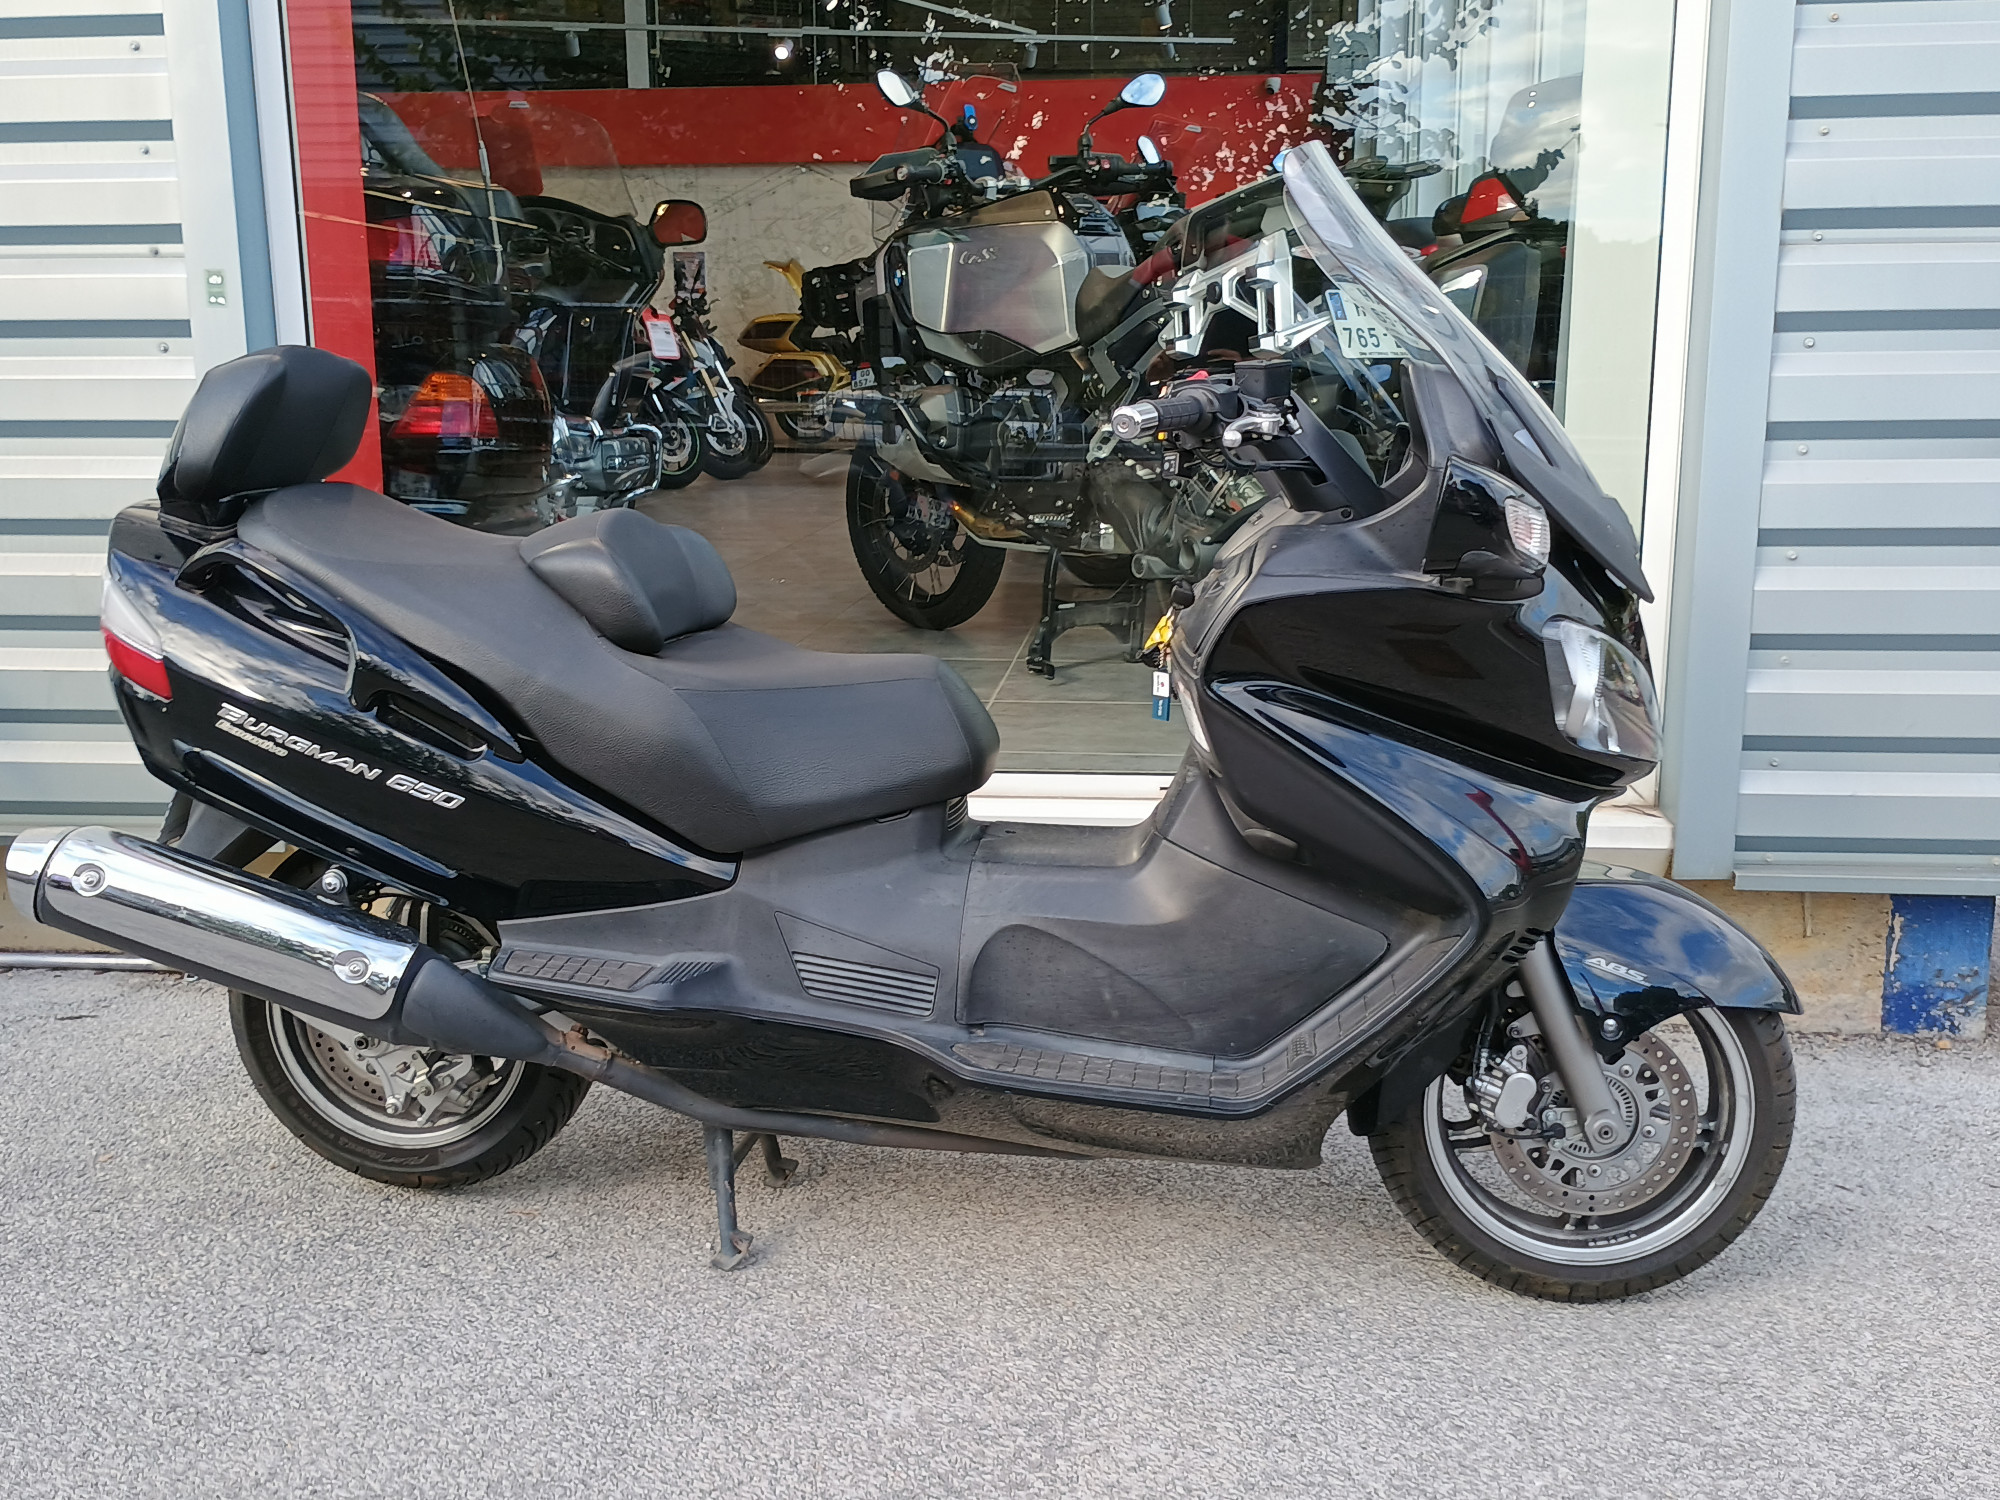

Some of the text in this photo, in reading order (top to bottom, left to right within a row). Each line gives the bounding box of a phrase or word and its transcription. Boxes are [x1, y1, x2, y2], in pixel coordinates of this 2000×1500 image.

[216, 702, 466, 809] BURGMAN 650
[1582, 957, 1649, 982] ABS
